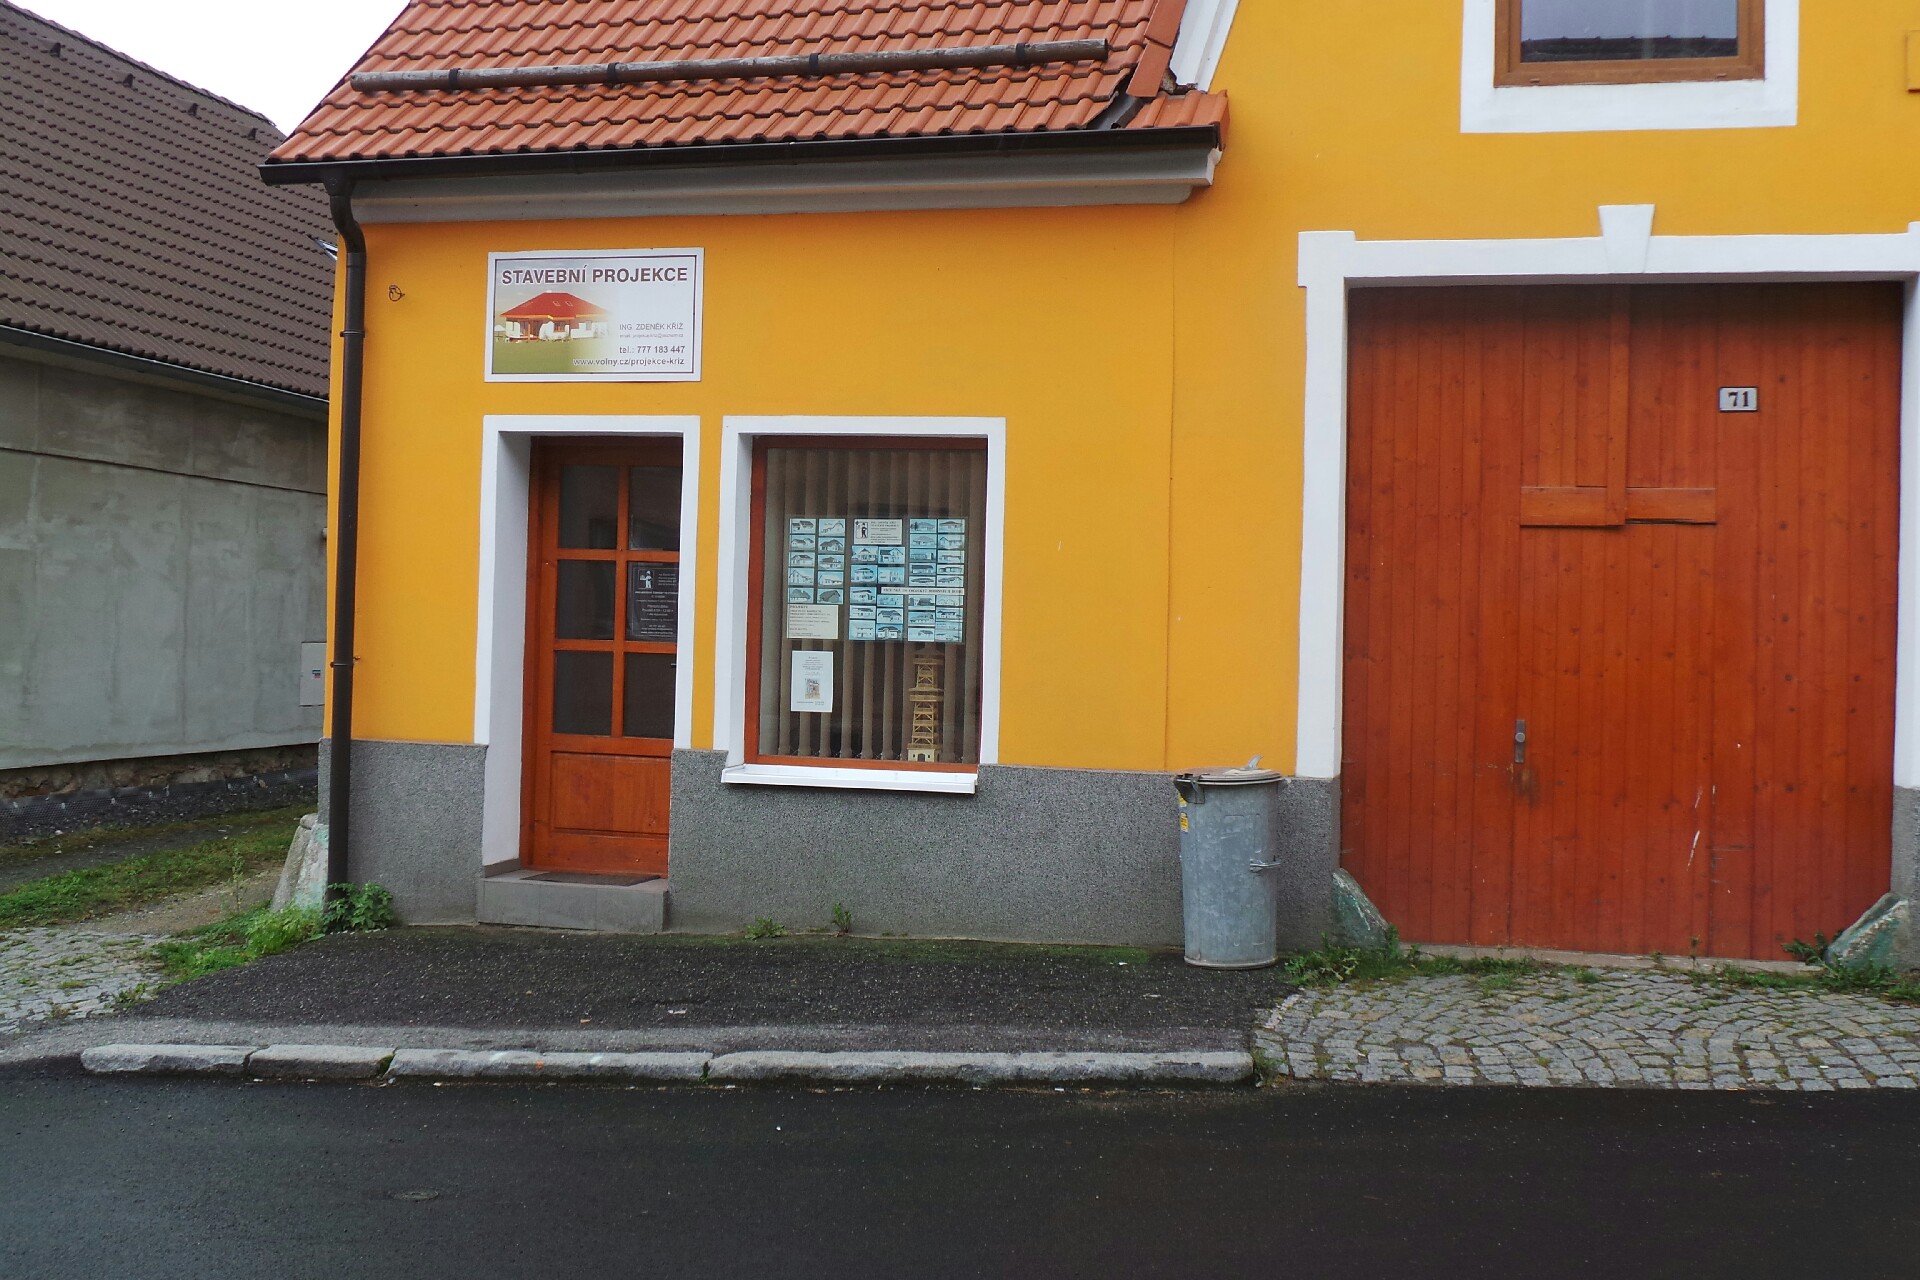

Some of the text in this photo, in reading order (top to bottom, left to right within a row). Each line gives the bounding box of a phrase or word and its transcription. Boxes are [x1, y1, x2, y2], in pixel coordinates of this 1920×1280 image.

[502, 265, 688, 285] STAVEBNÍ PROJEKCE
[635, 322, 665, 331] ZDENĚK
[619, 345, 686, 354] tel.: 777 183 447
[573, 358, 685, 366] www.volny.cz/projekce-kriz
[1728, 390, 1749, 407] 71
